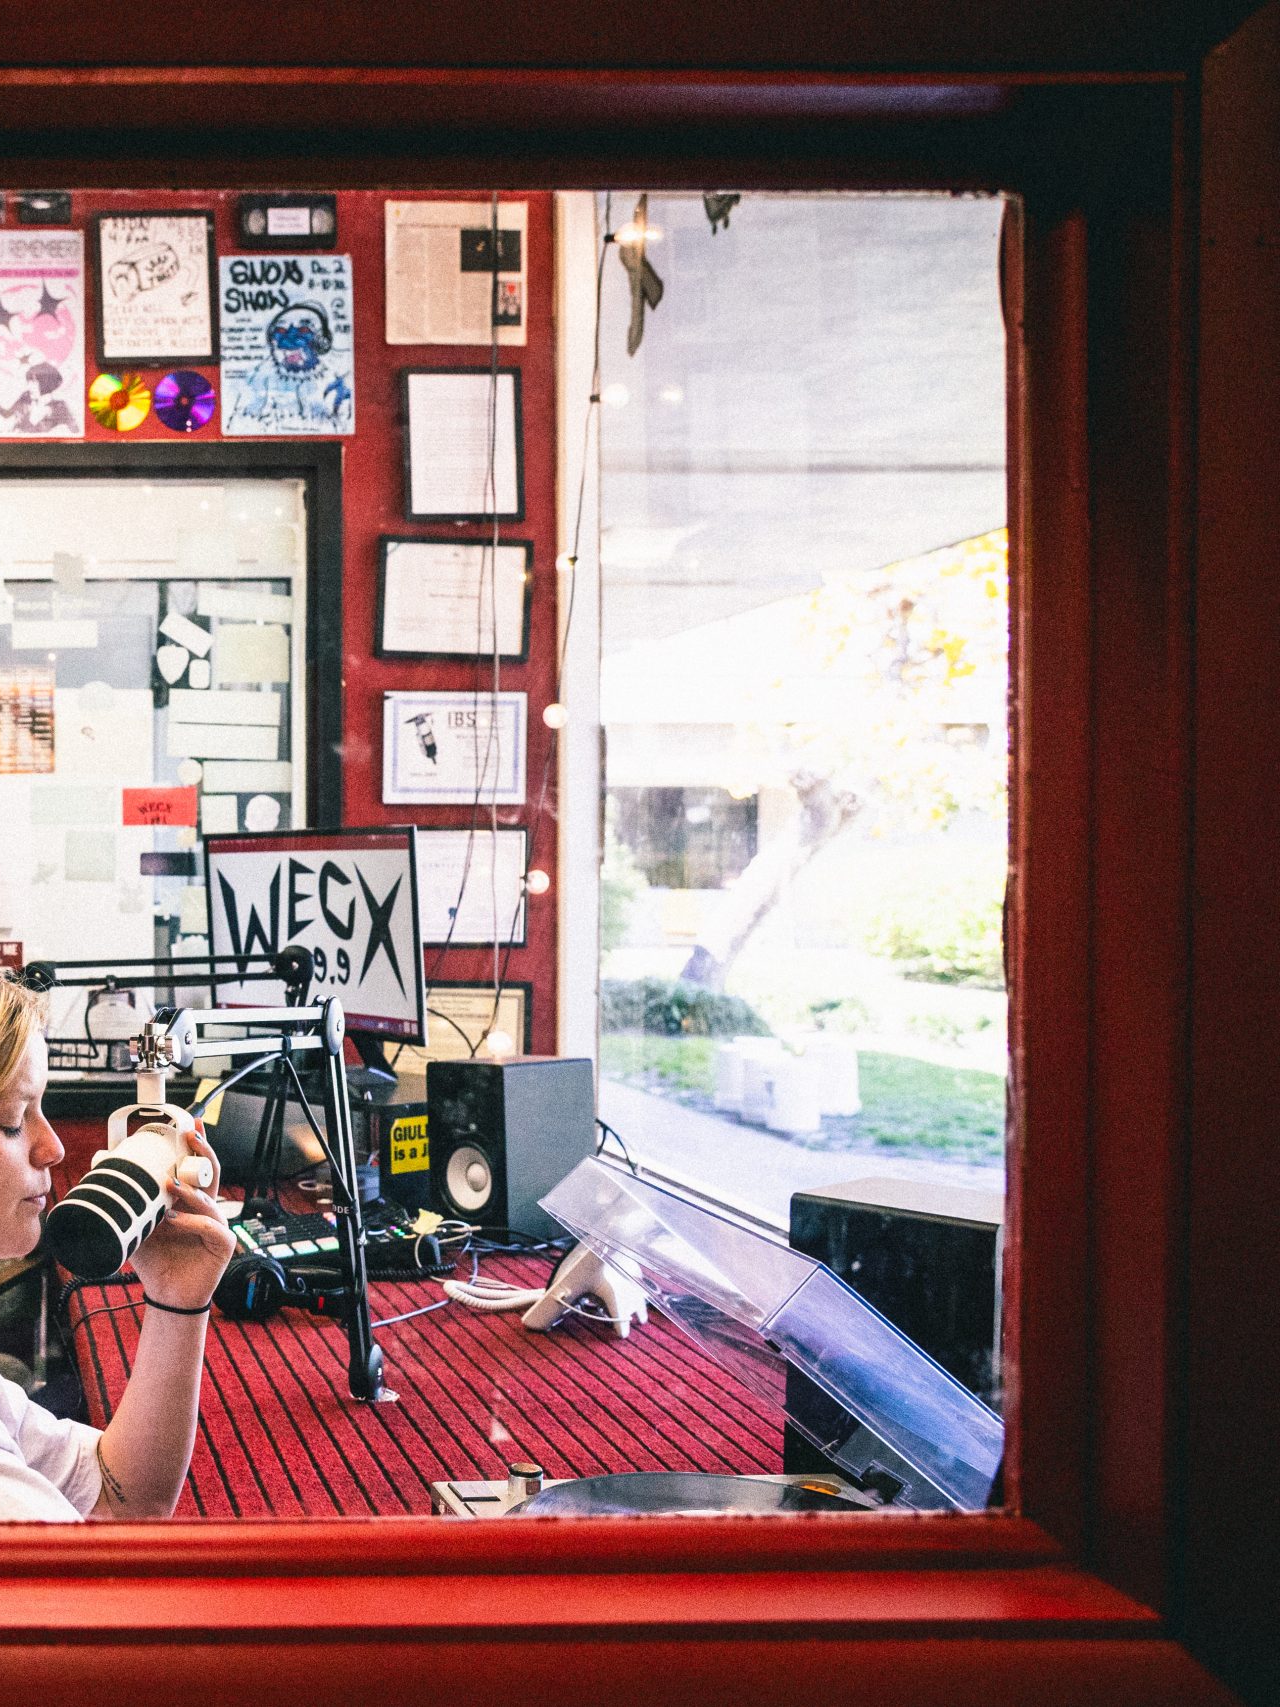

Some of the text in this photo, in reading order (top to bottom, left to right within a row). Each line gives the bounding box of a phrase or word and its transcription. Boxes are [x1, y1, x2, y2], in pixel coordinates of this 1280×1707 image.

[224, 287, 289, 313] SHOW
[394, 1146, 405, 1161] is
[409, 1147, 417, 1159] a
